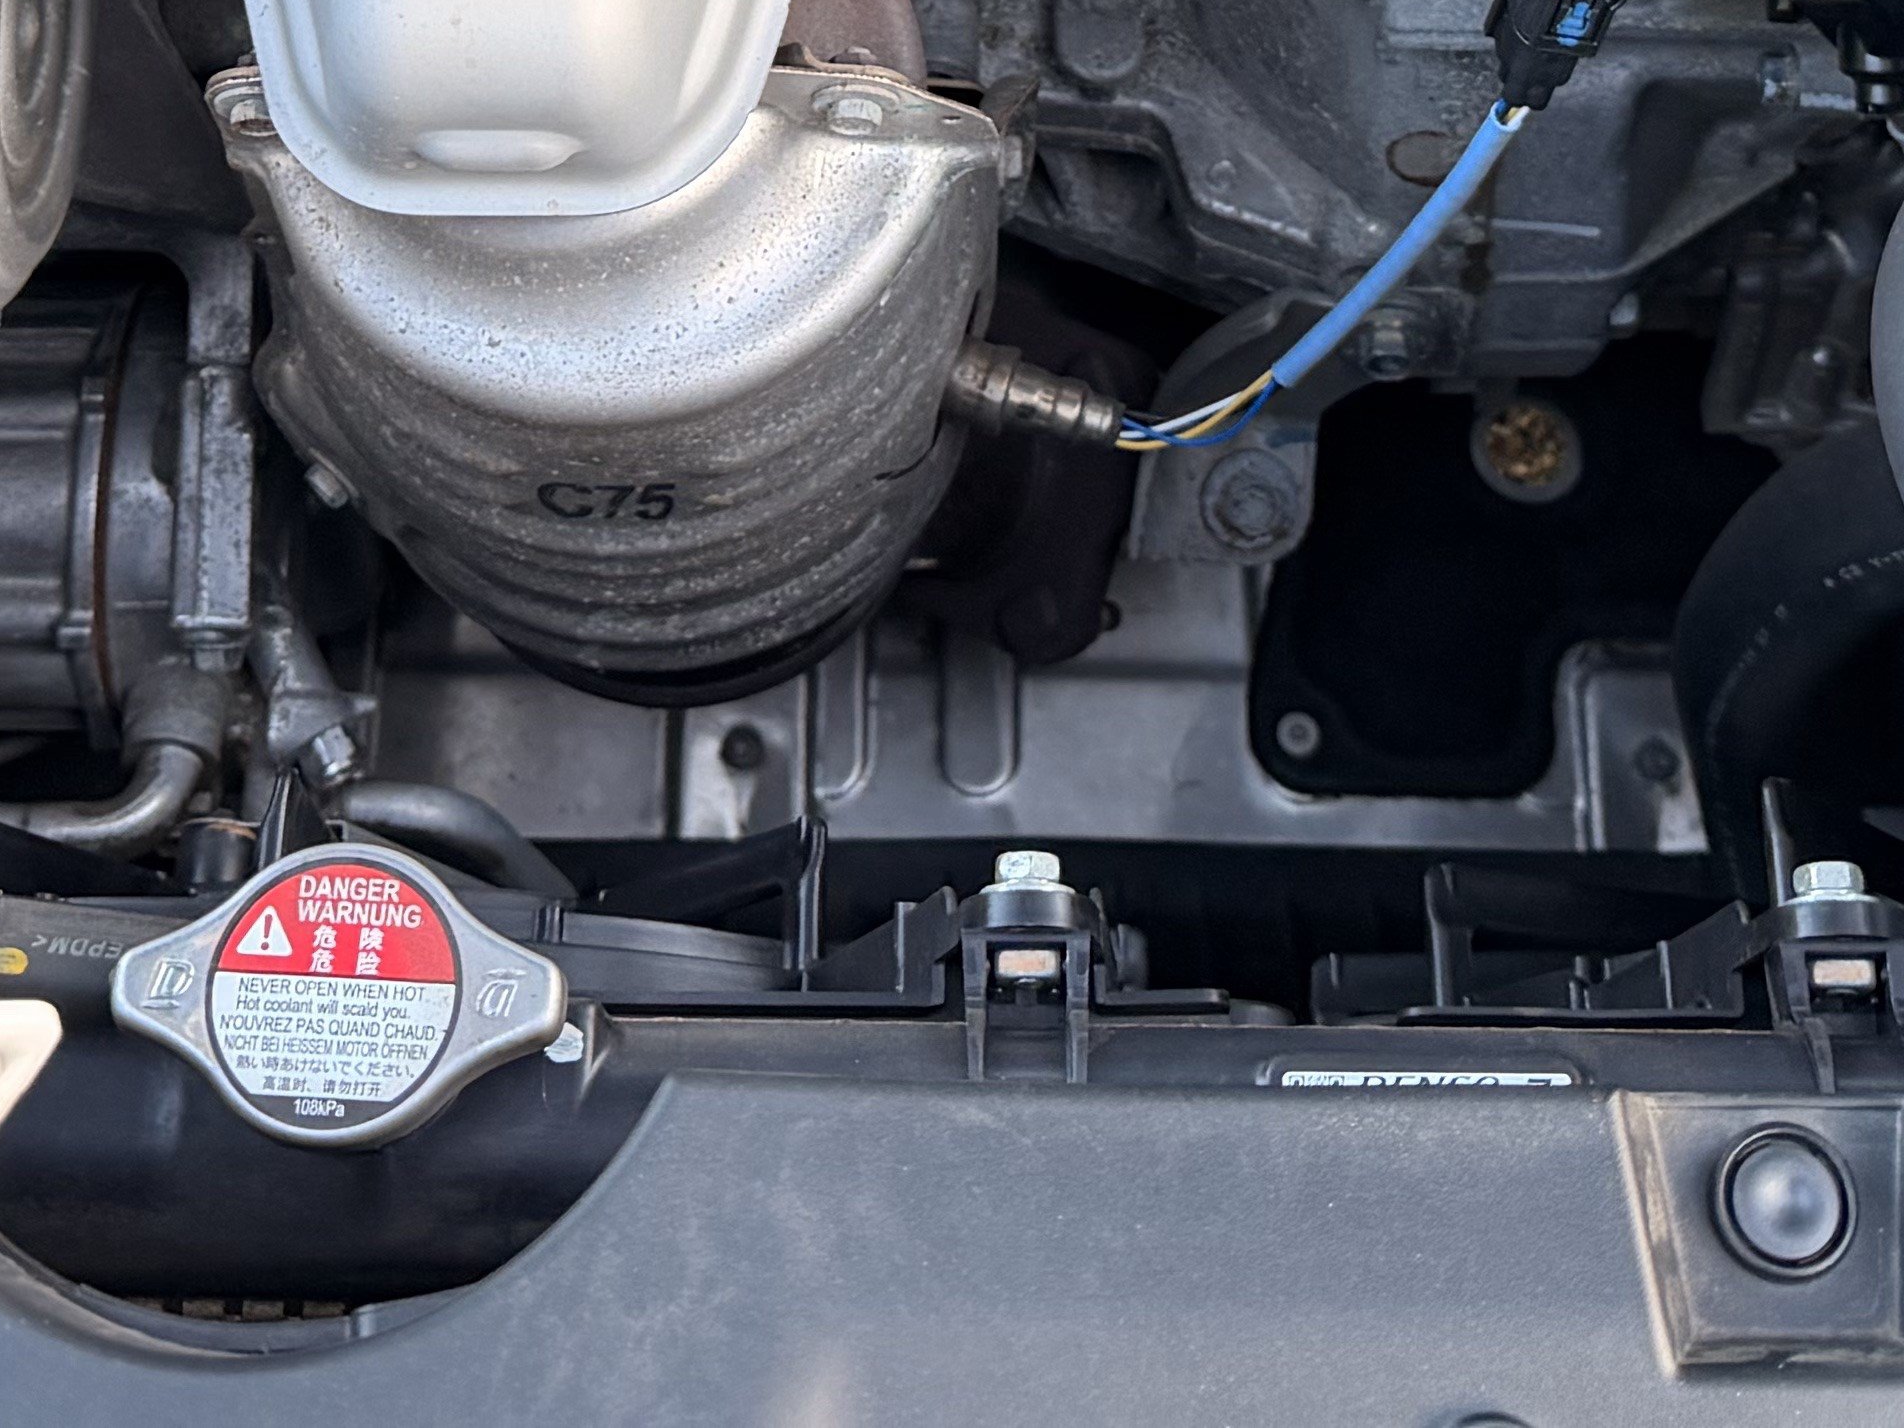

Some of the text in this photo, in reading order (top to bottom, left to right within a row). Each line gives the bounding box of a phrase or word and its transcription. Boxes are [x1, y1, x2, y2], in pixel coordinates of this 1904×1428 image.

[537, 481, 676, 521] C75
[299, 875, 401, 903] DANGER
[298, 899, 422, 929] WARNUNG
[238, 977, 292, 996] NEVER
[294, 979, 338, 998] OPEN
[342, 982, 390, 1001] WHEN
[236, 995, 411, 1023] Hot coolant will scald you.
[219, 1014, 438, 1042] N'OUVREZ PAS QUAND CHAUD.
[224, 1033, 258, 1052] NICHT
[260, 1036, 279, 1052] BEI
[279, 1038, 332, 1056] HEISSEM
[335, 1040, 378, 1058] MOTOR
[293, 1098, 346, 1118] 108kPa
